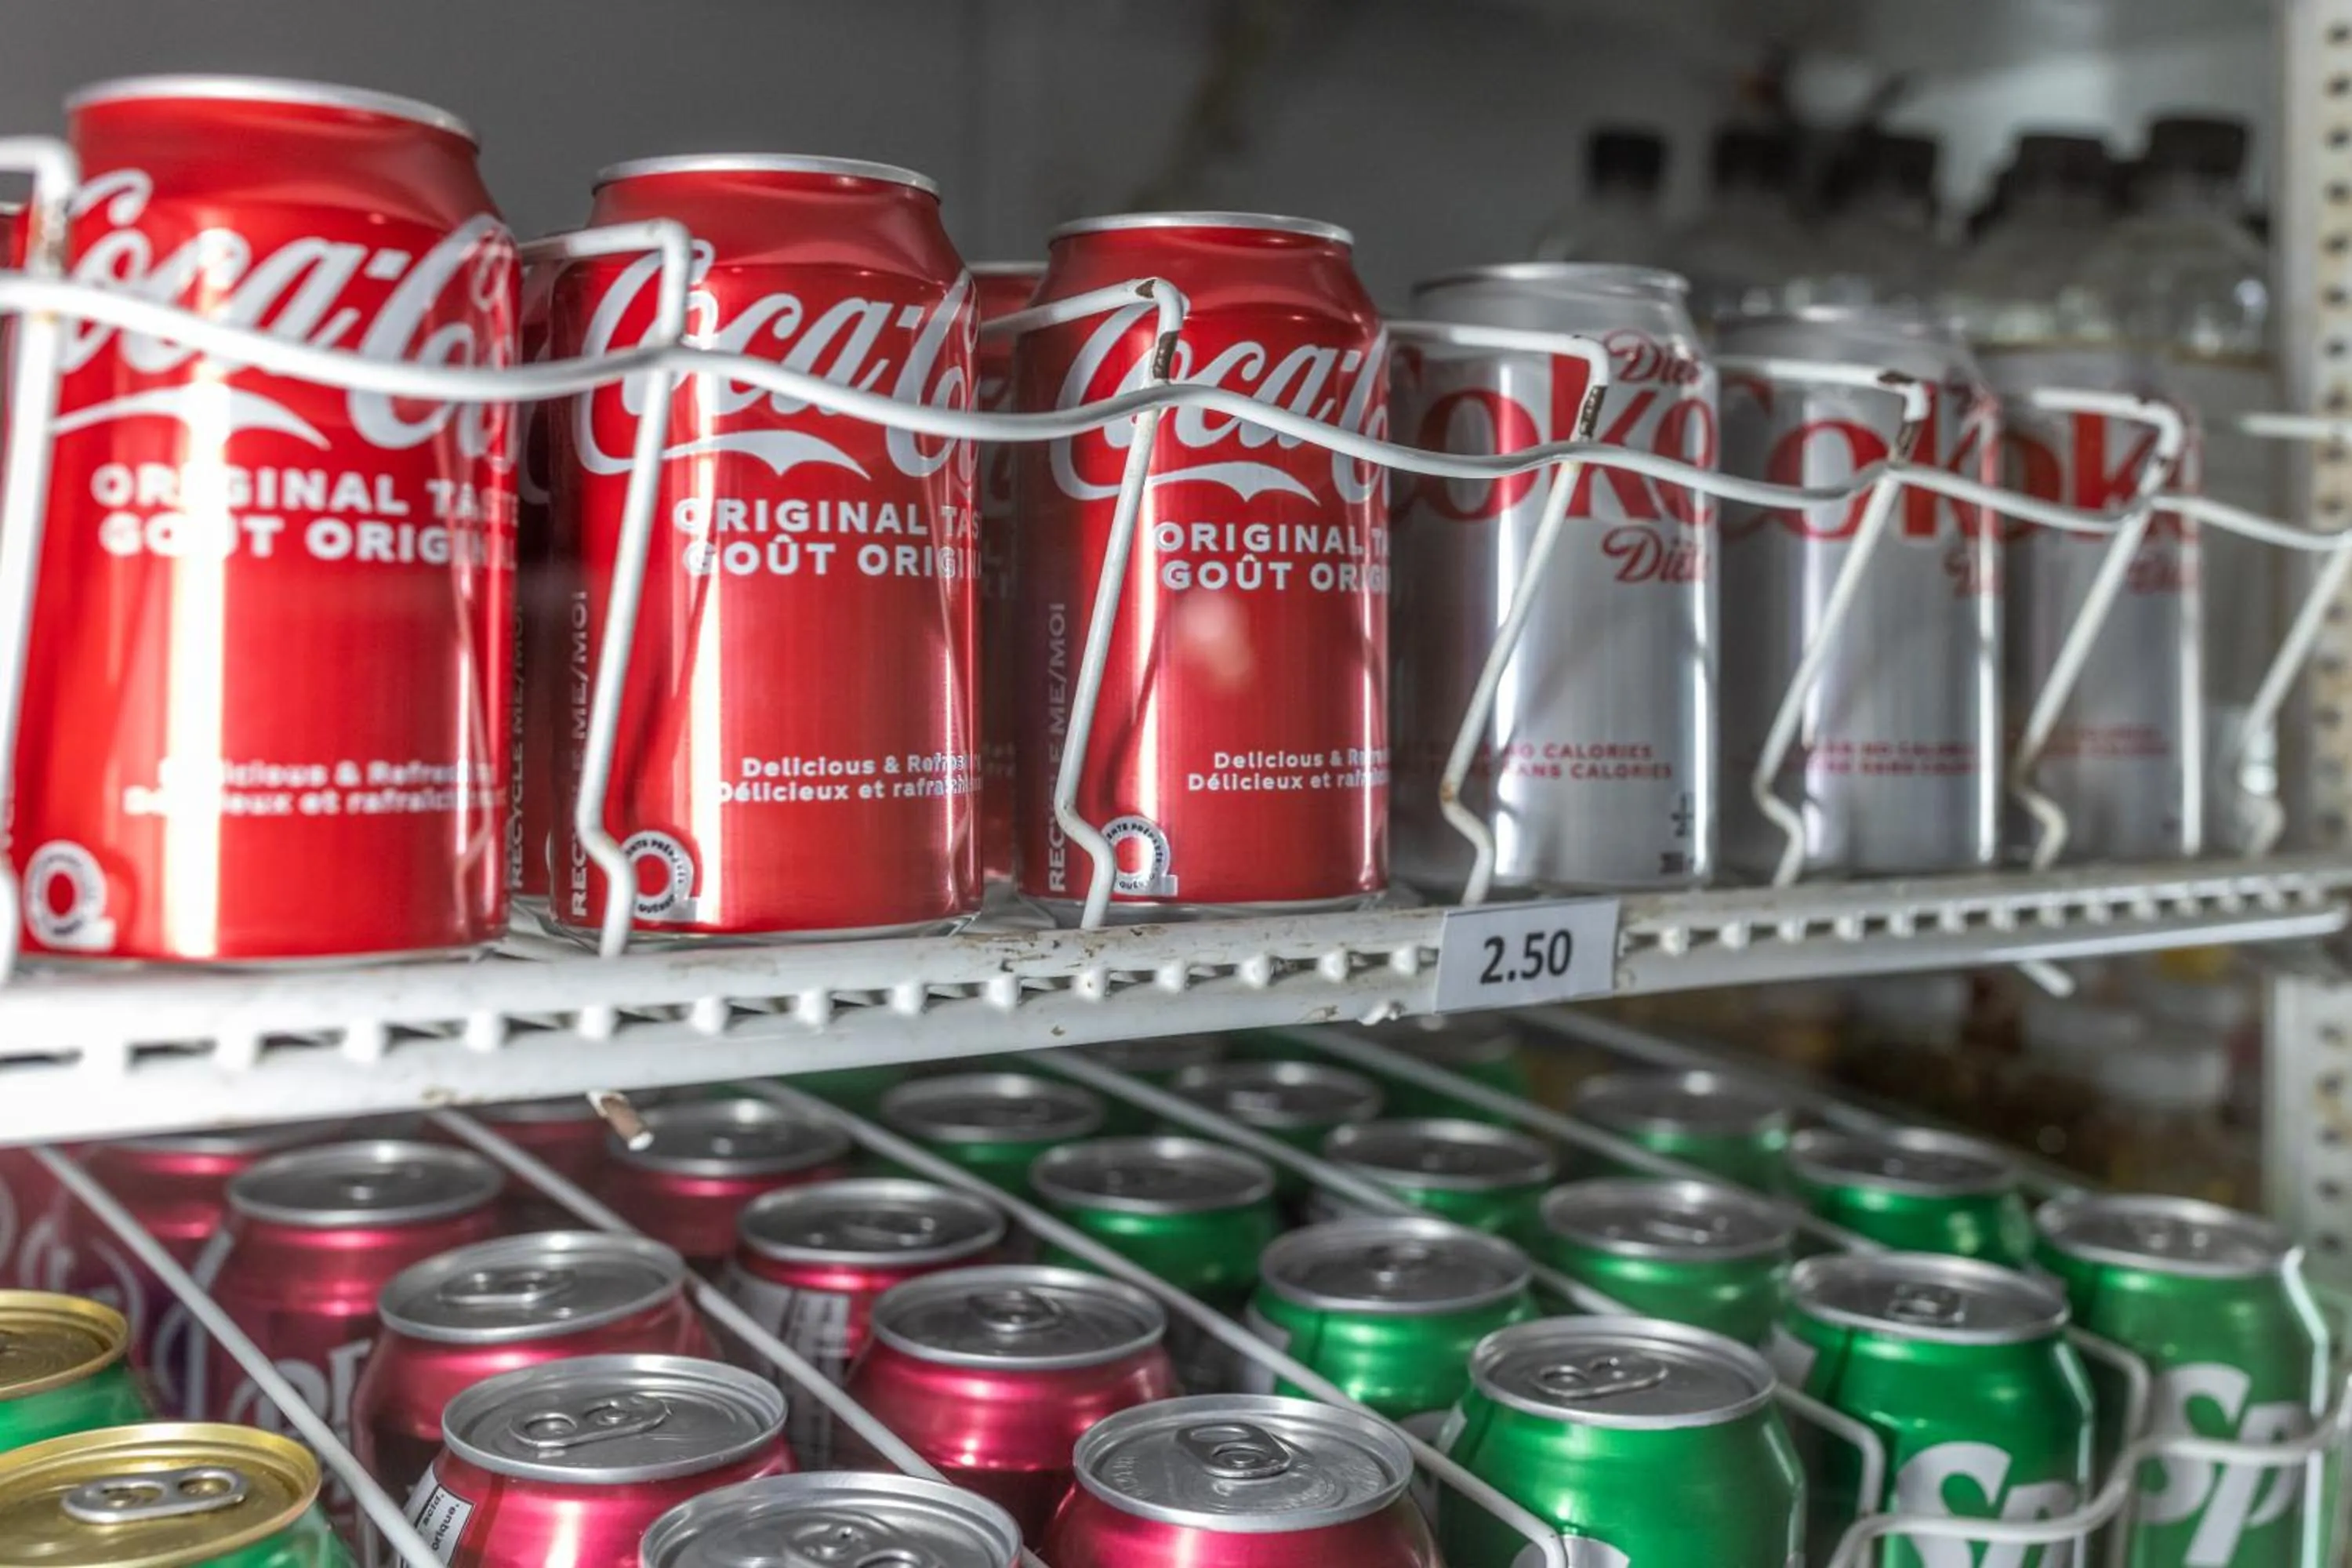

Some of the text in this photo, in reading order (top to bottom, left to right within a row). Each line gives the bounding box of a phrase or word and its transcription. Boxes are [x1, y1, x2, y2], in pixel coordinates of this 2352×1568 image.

[90, 462, 408, 515] ORGINAL
[675, 498, 928, 534] ORIGINAL
[683, 534, 837, 575] GOÛT
[1154, 521, 1364, 554] ORIGINAL
[1162, 553, 1293, 591] GOÛT
[572, 591, 589, 739] ME/MOI
[1049, 603, 1066, 735] ME/MOI
[742, 757, 876, 778] Delicious
[884, 755, 900, 774] &
[1214, 750, 1324, 768] Delicious
[858, 777, 886, 799] et
[1188, 771, 1303, 792] Délicieux
[1310, 771, 1331, 789] et
[1479, 929, 1573, 985] 2.50
[431, 1503, 459, 1552] orique.
